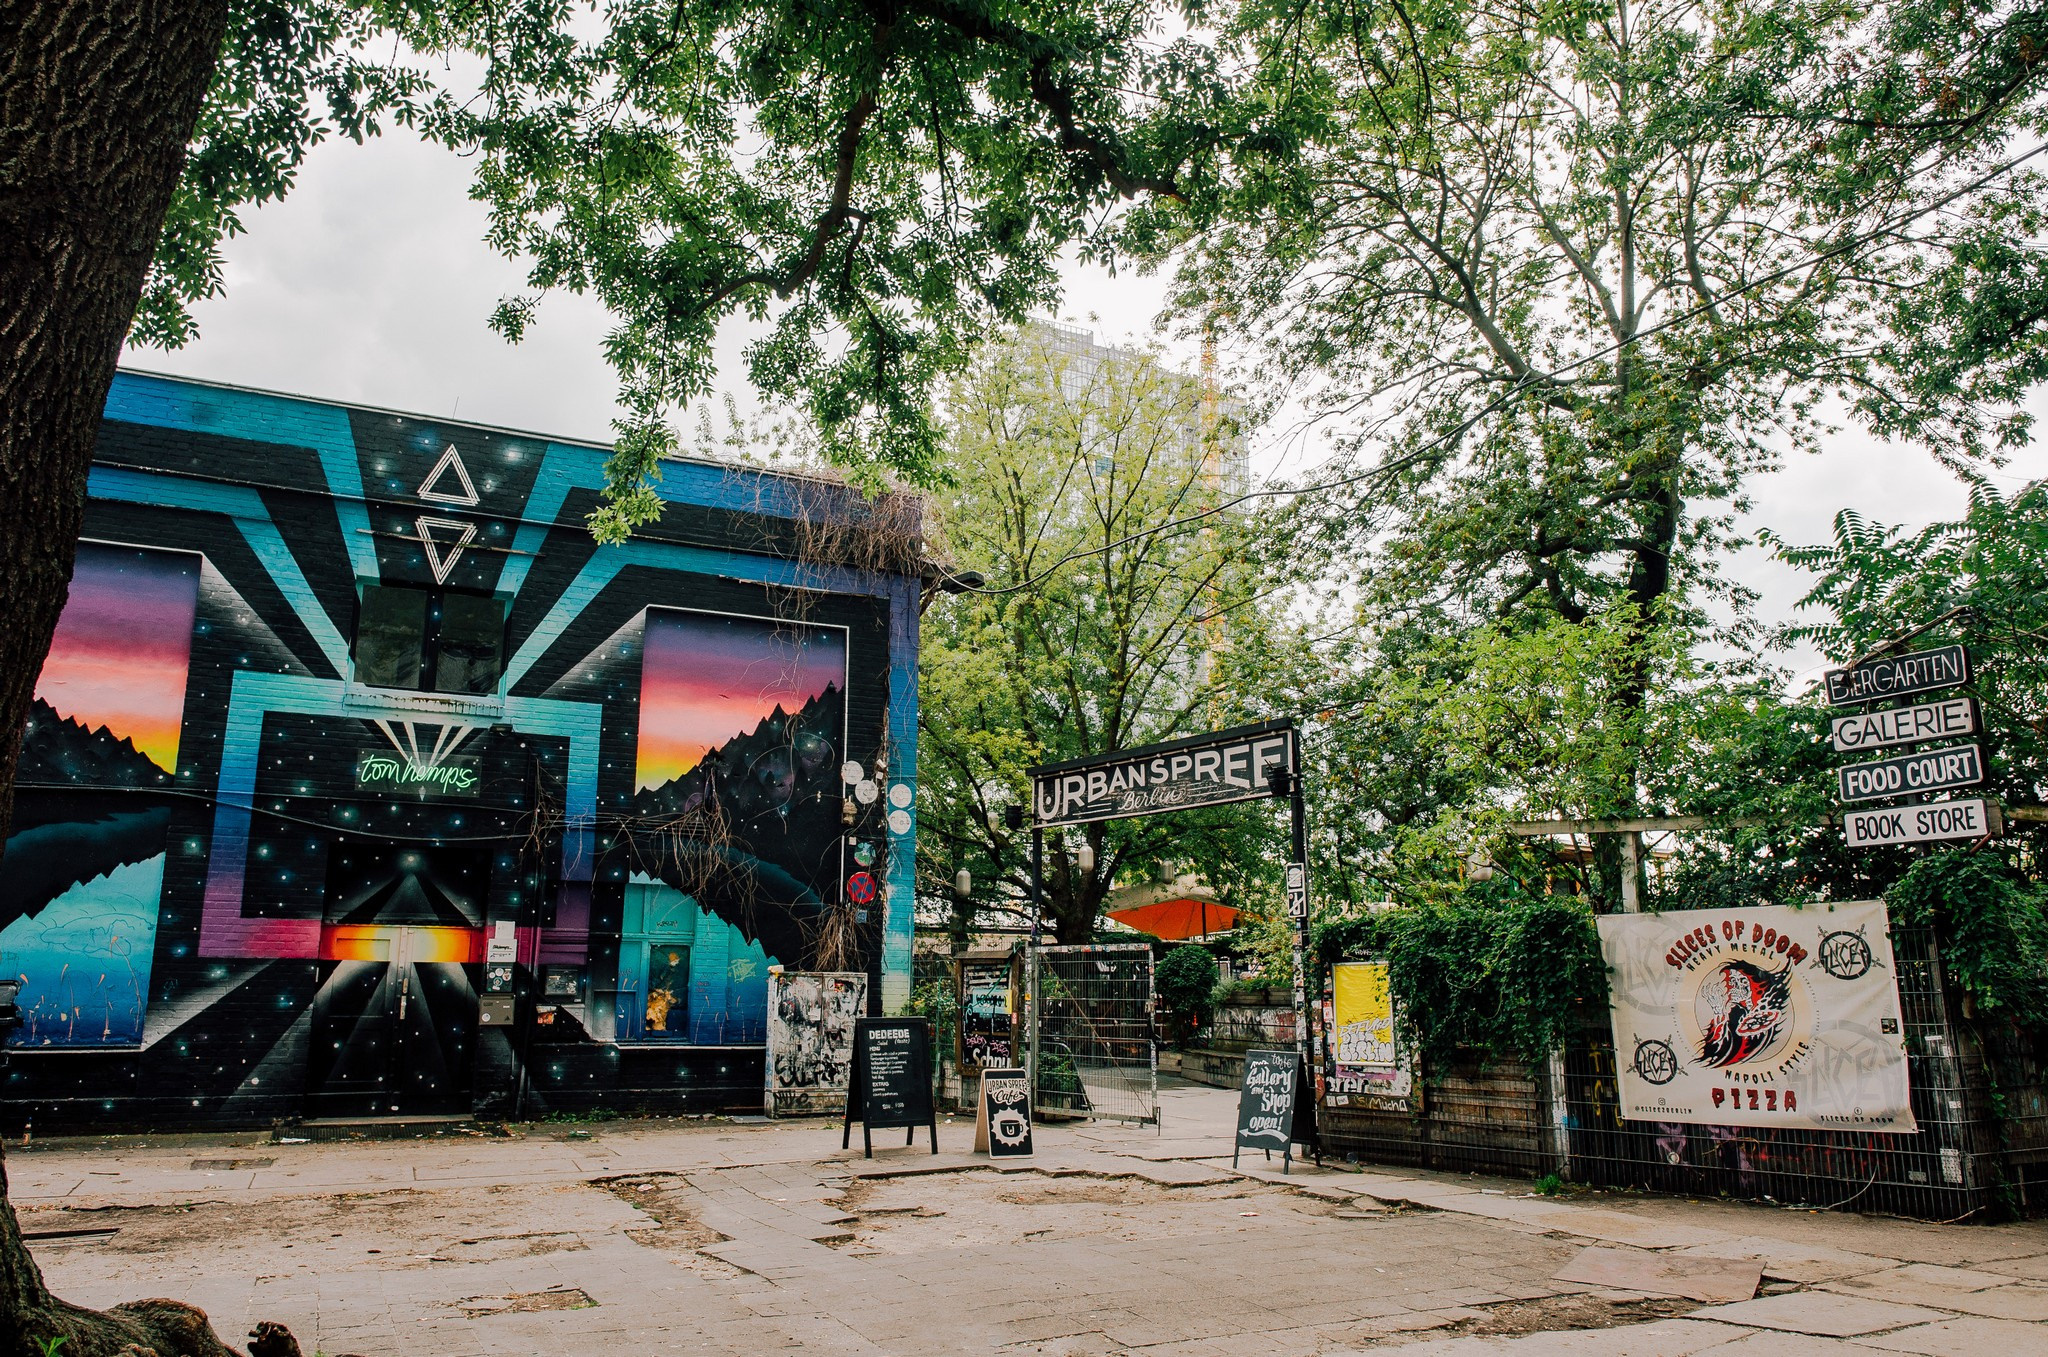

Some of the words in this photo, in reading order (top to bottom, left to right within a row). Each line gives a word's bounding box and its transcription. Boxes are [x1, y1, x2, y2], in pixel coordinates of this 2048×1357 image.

[1838, 702, 1966, 746] GALERIE
[360, 754, 399, 783] tom
[1846, 765, 1902, 796] FOOD
[1907, 752, 1972, 787] COURT
[1118, 788, 1183, 811] Berlin
[1855, 813, 1906, 841] BOOK
[1916, 806, 1977, 836] STORE
[1665, 924, 1716, 970] SLICES
[1722, 920, 1745, 941] OF
[1752, 922, 1808, 966] DOOM
[1686, 945, 1720, 971] HEAVY
[1730, 943, 1774, 960] METAL
[1725, 1070, 1774, 1084] NAPOLI
[1779, 1041, 1809, 1075] STYLE
[987, 1080, 1007, 1092] URBAN
[1008, 1080, 1027, 1092] SPREE
[1246, 1065, 1293, 1093] Gallery
[995, 1089, 1020, 1103] Café
[1261, 1086, 1291, 1115] Shop
[1711, 1087, 1797, 1112] PIZZA
[1249, 1116, 1284, 1131] open!
